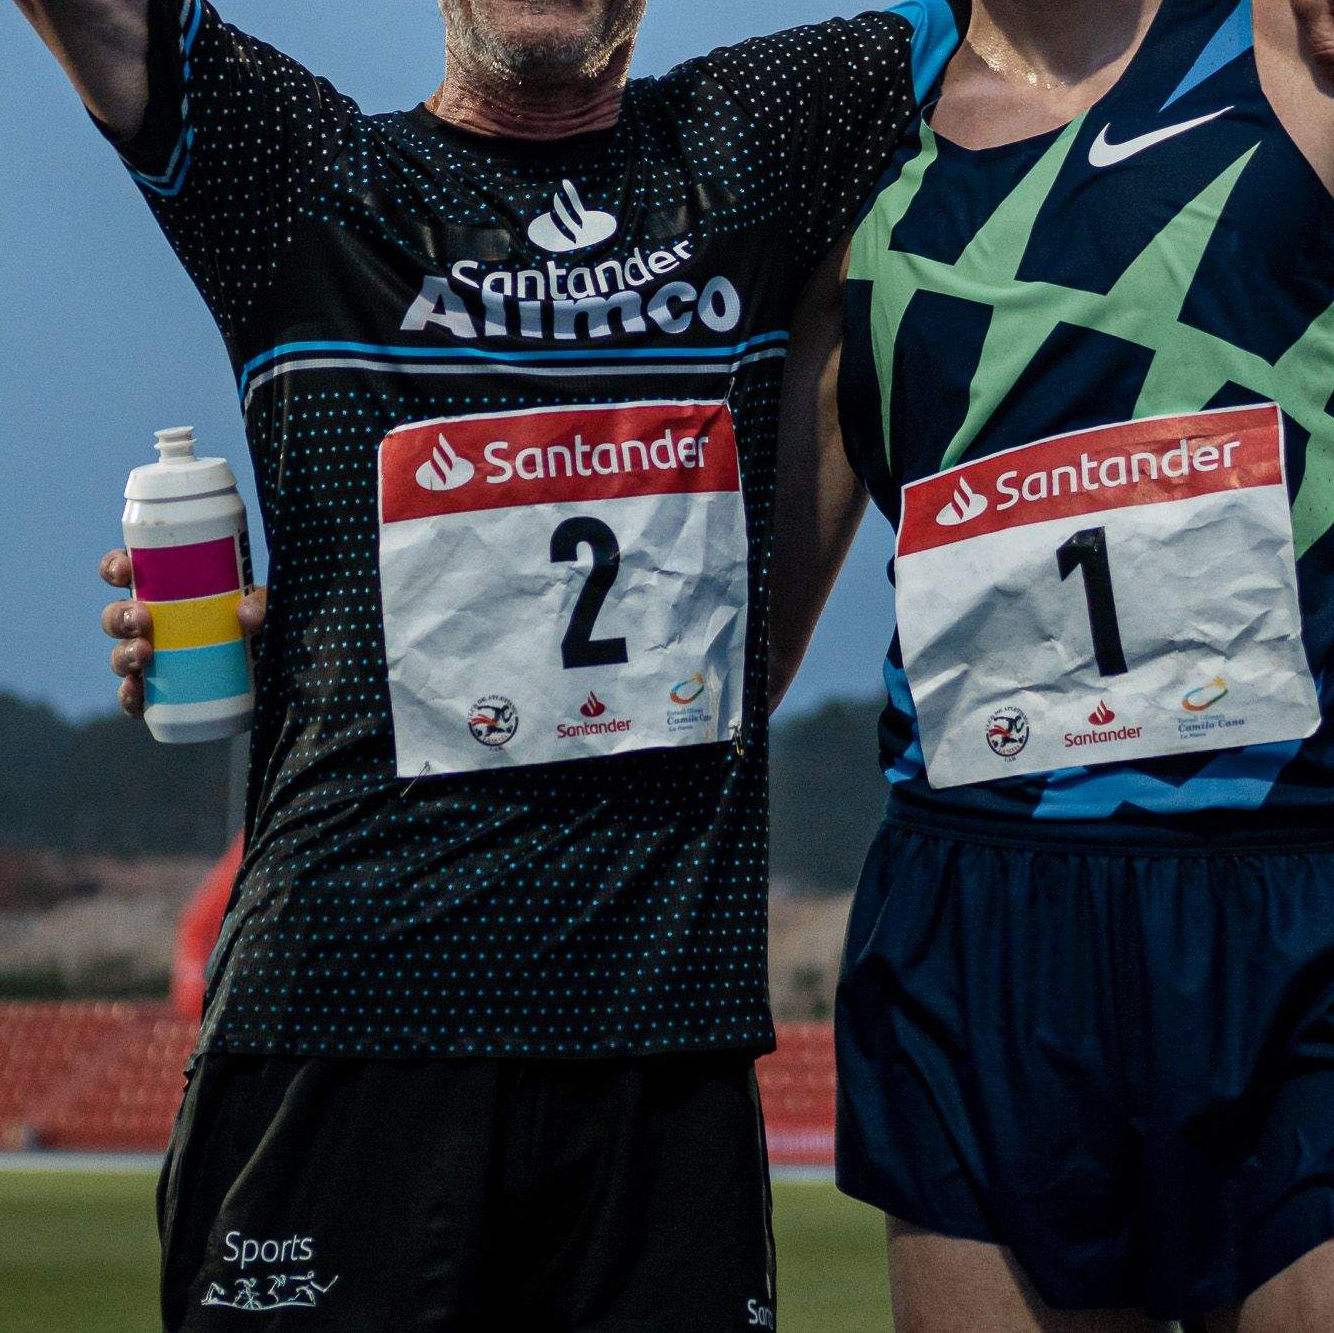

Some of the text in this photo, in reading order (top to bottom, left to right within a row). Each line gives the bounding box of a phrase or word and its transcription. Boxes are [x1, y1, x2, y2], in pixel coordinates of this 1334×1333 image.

[452, 239, 693, 301] Santander
[483, 428, 710, 485] Santander
[995, 437, 1242, 512] Santander
[549, 515, 629, 670] 2
[1055, 525, 1129, 678] 1
[556, 717, 632, 739] Santander
[1063, 724, 1143, 749] Santander
[223, 1230, 314, 1269] Sports
